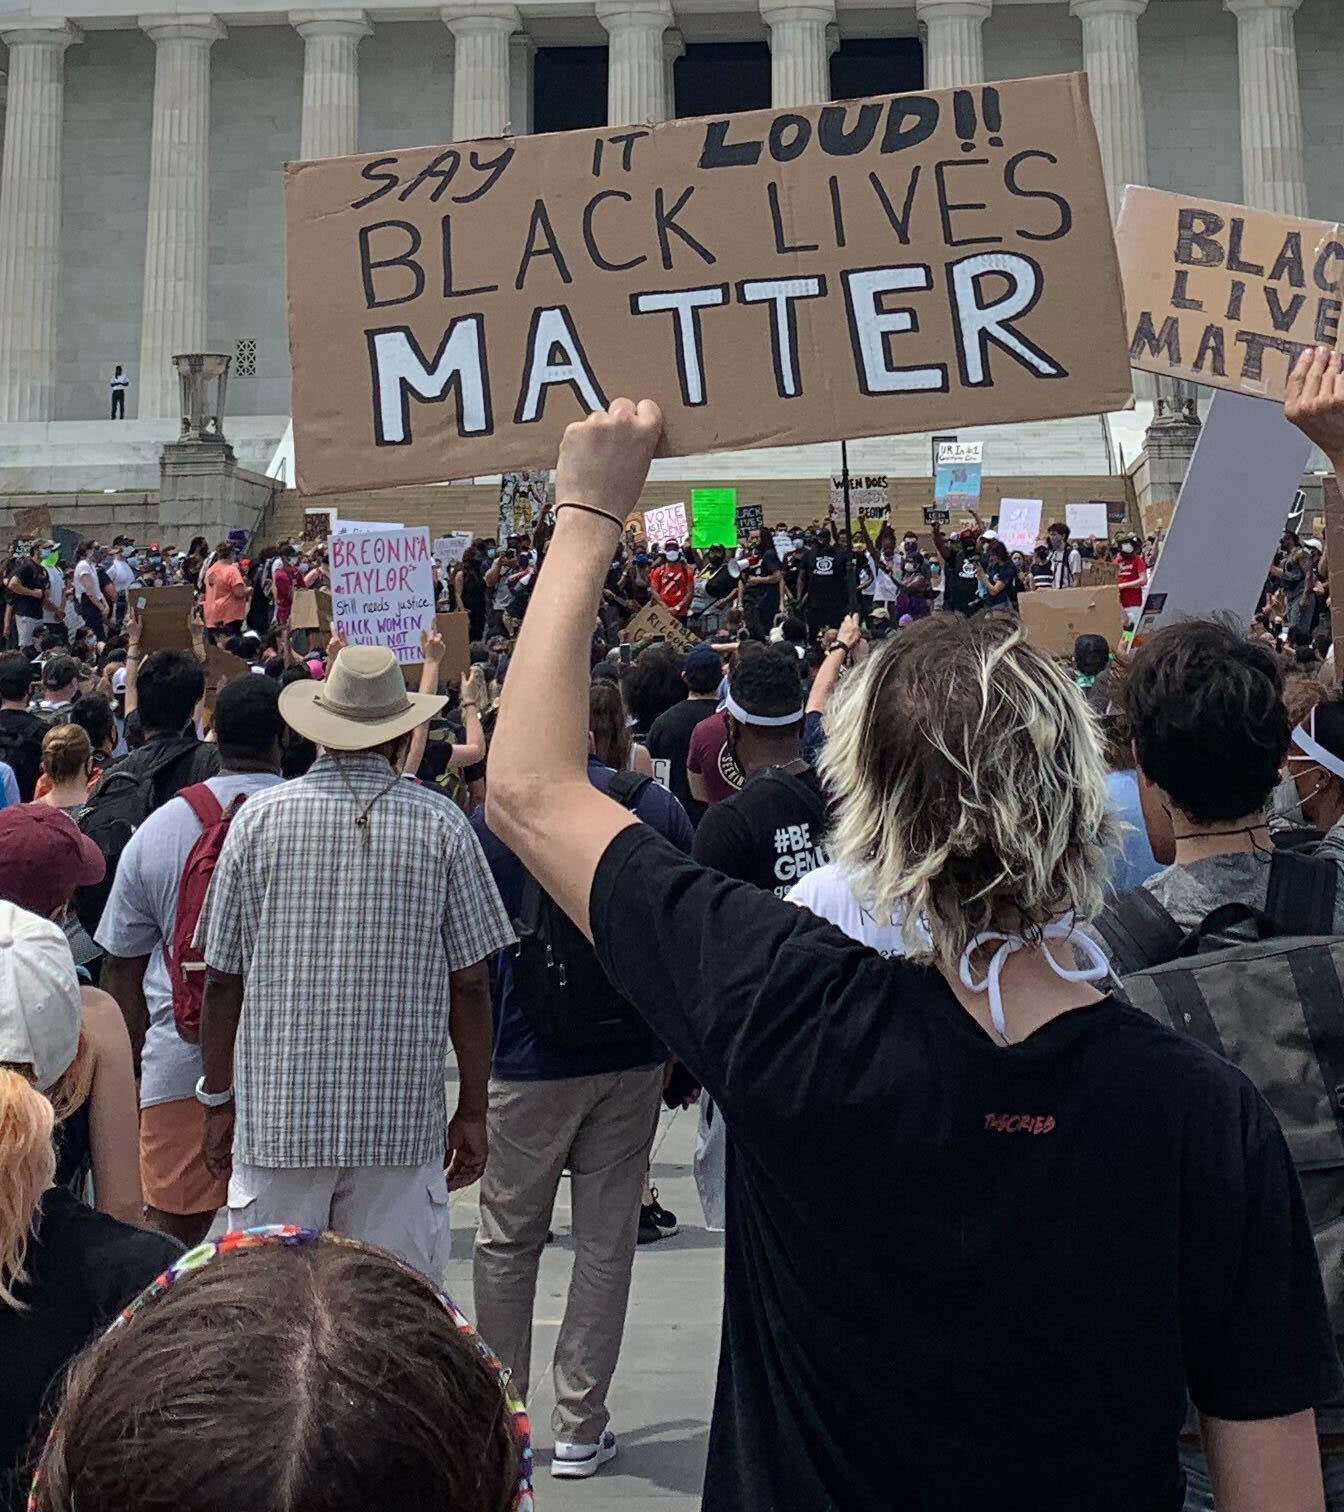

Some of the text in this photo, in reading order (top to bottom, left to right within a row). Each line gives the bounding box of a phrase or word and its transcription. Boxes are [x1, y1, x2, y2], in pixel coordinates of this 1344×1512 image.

[351, 87, 1004, 209] SAY IT LOUD!!
[358, 149, 1073, 309] BLACK LIVES
[365, 250, 1070, 447] MATTER
[833, 477, 863, 490] WEN
[646, 504, 683, 524] VOTE
[739, 517, 763, 528] IVES
[332, 534, 430, 569] BREONNA
[341, 566, 415, 595] TAYLOR
[336, 598, 357, 616] Still
[363, 596, 391, 614] needs
[336, 614, 423, 637] BLACK WOMEN
[387, 630, 409, 646] NOT
[721, 754, 745, 787] SEEKIN
[773, 822, 813, 854] #BE
